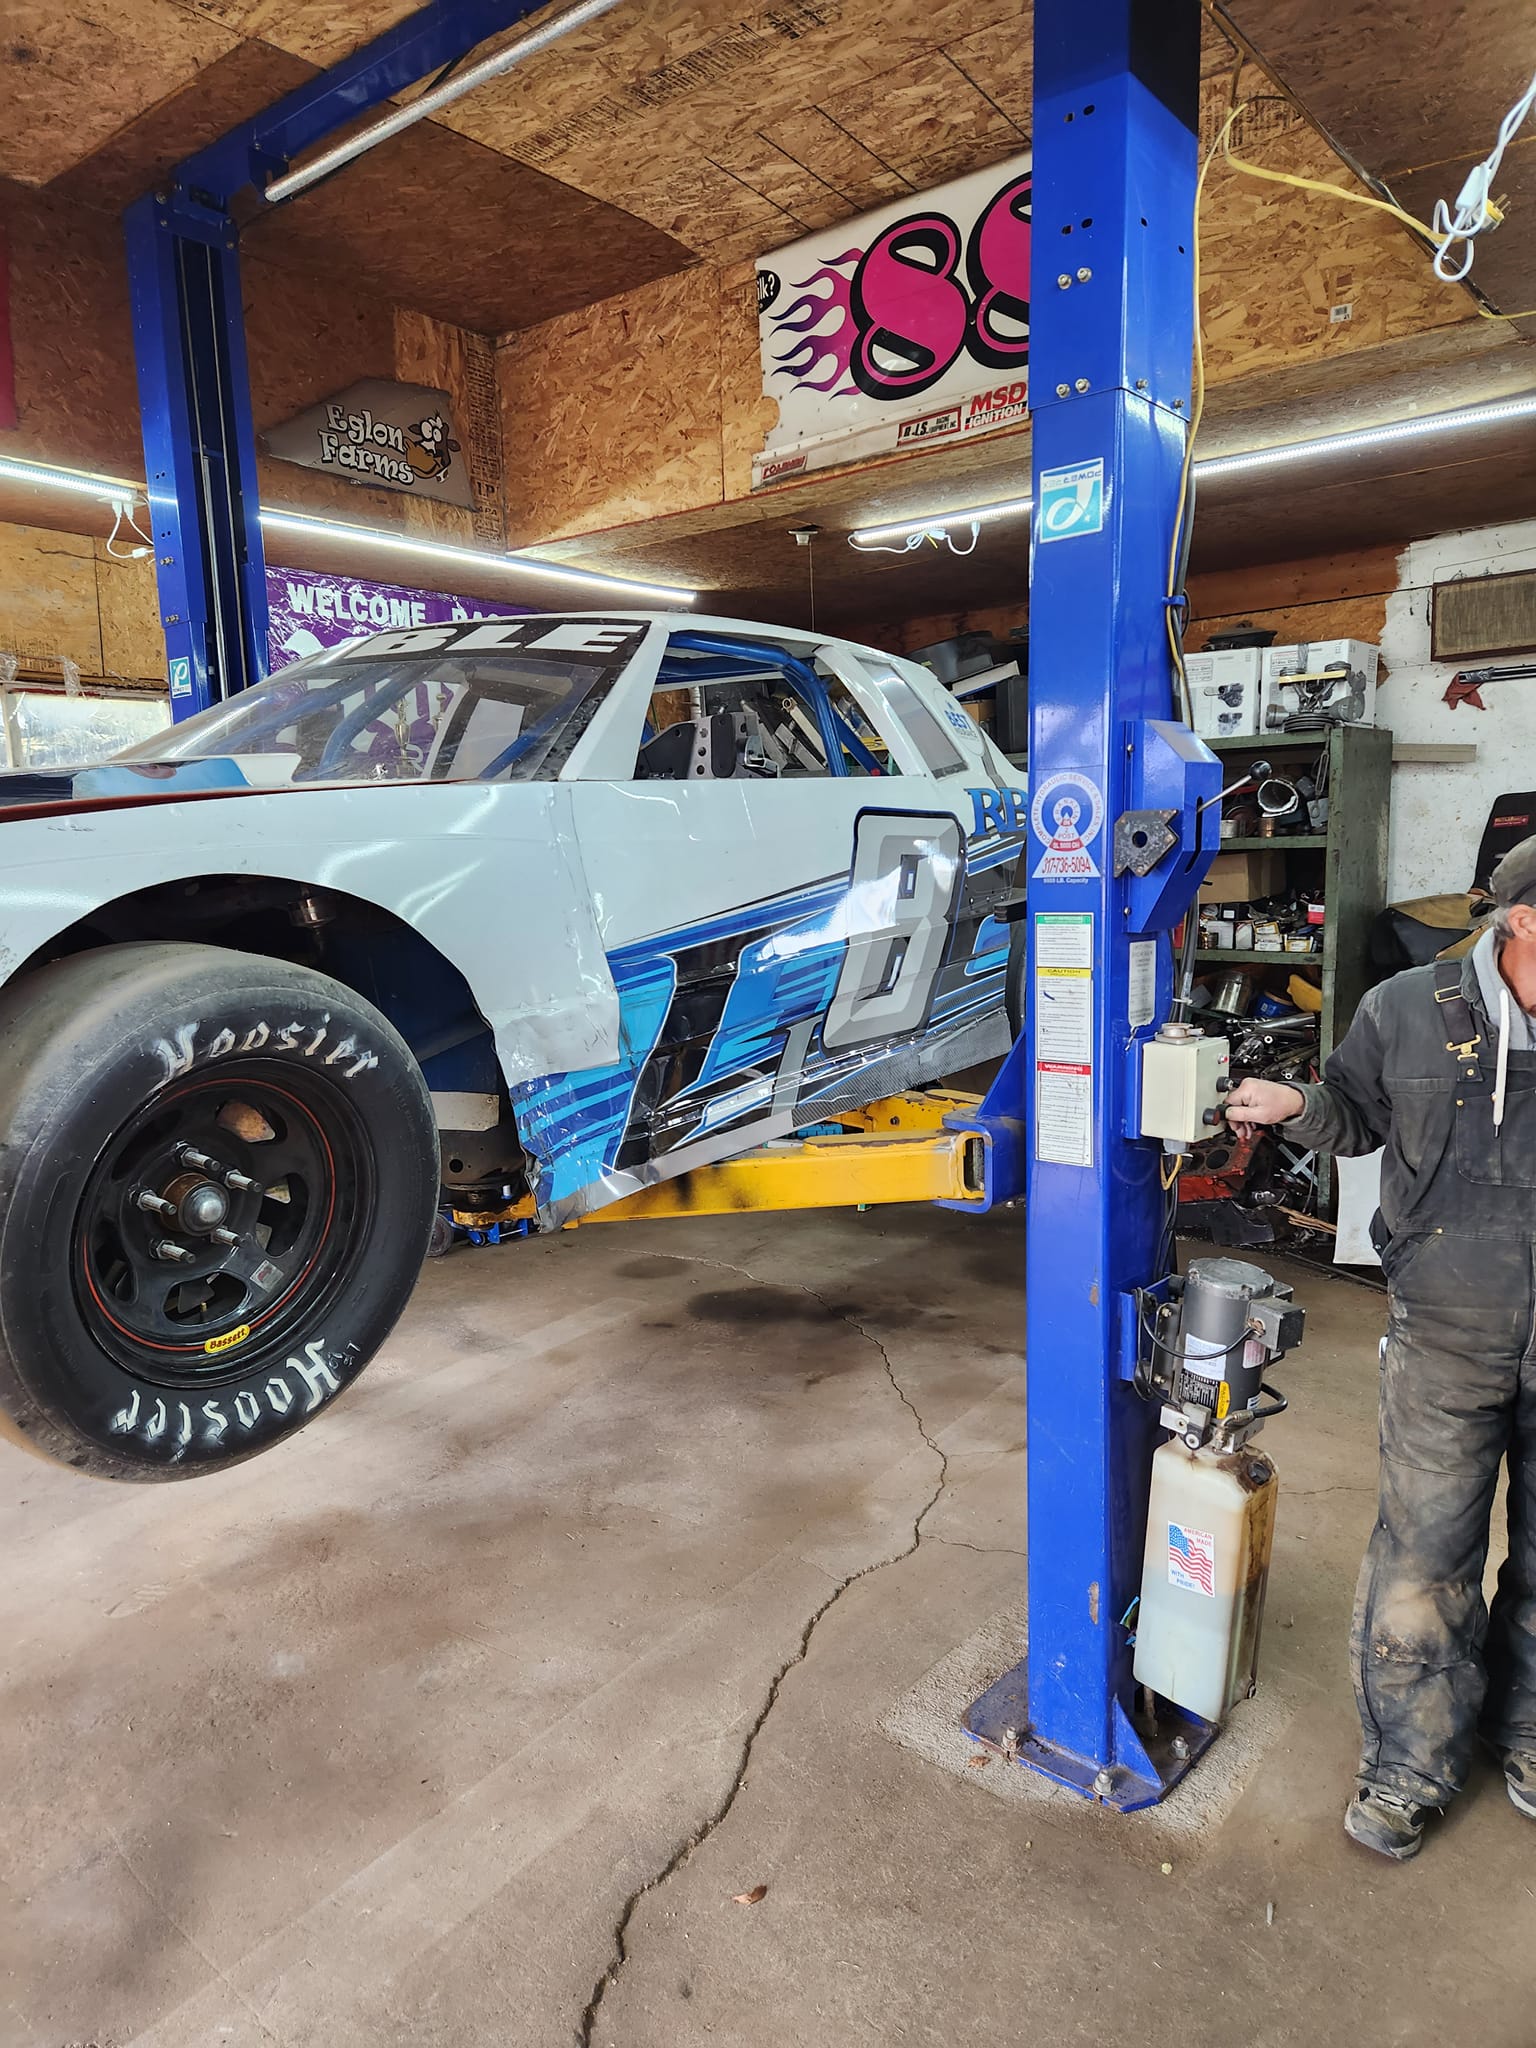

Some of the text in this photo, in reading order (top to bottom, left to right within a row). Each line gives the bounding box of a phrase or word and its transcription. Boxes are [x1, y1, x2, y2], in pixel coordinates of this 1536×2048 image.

[970, 381, 1027, 415] MSD
[325, 403, 405, 452] Eglon
[967, 402, 1023, 429] IGNITION
[319, 429, 415, 485] Farms
[286, 582, 426, 628] WELCOME
[344, 624, 643, 660] BLE
[209, 1328, 246, 1349] Bassett
[1183, 1527, 1212, 1540] AMERICAN
[1196, 1538, 1212, 1547] MADE
[1171, 1570, 1185, 1579] WITH
